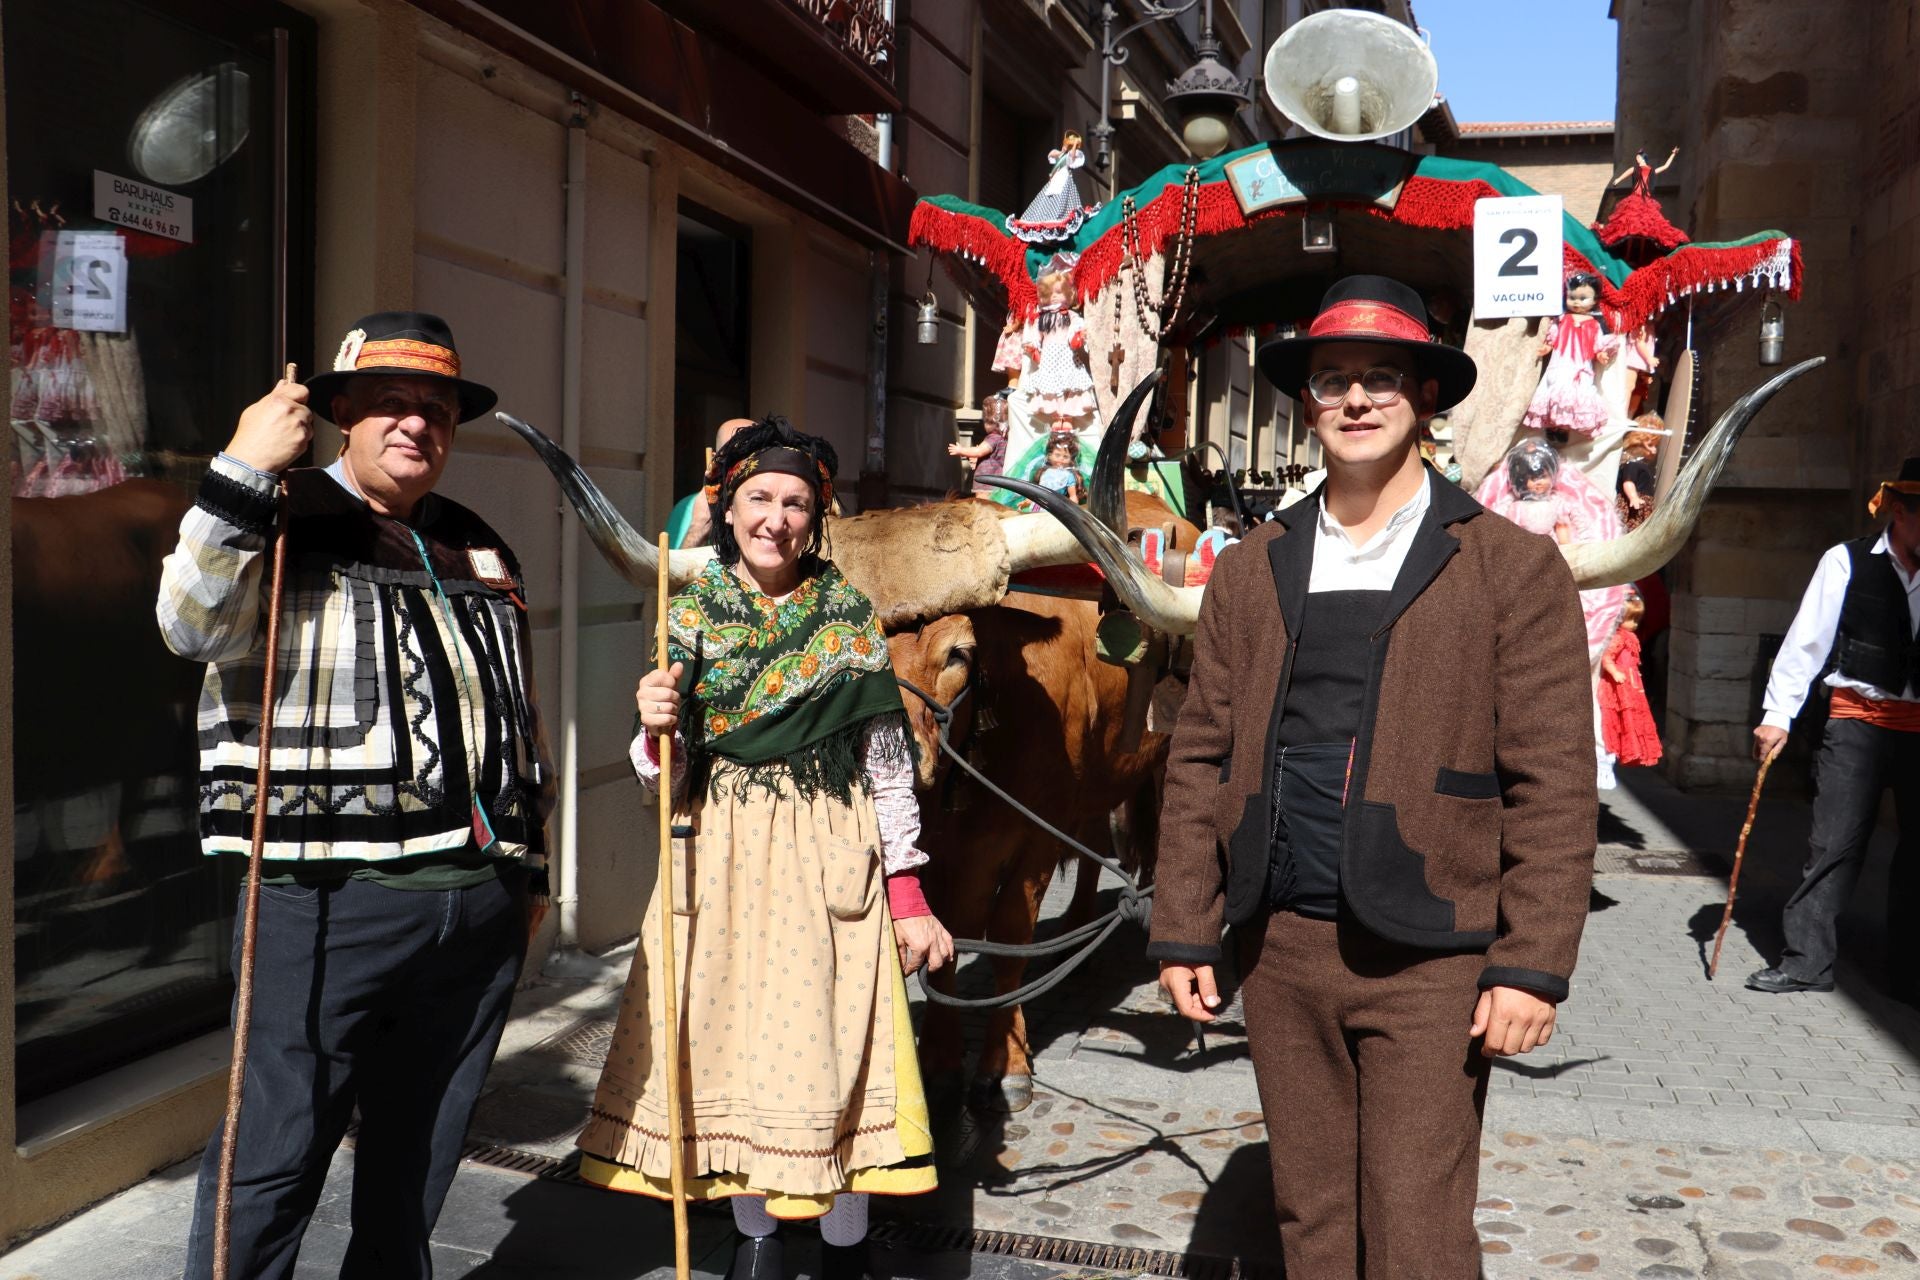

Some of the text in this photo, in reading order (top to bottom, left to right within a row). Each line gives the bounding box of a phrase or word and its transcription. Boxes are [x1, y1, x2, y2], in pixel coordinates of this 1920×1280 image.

[114, 180, 174, 209] BARUHAUS
[122, 211, 180, 236] 644 46 96 87
[1497, 228, 1539, 277] 2
[1493, 292, 1545, 302] VACUNO
